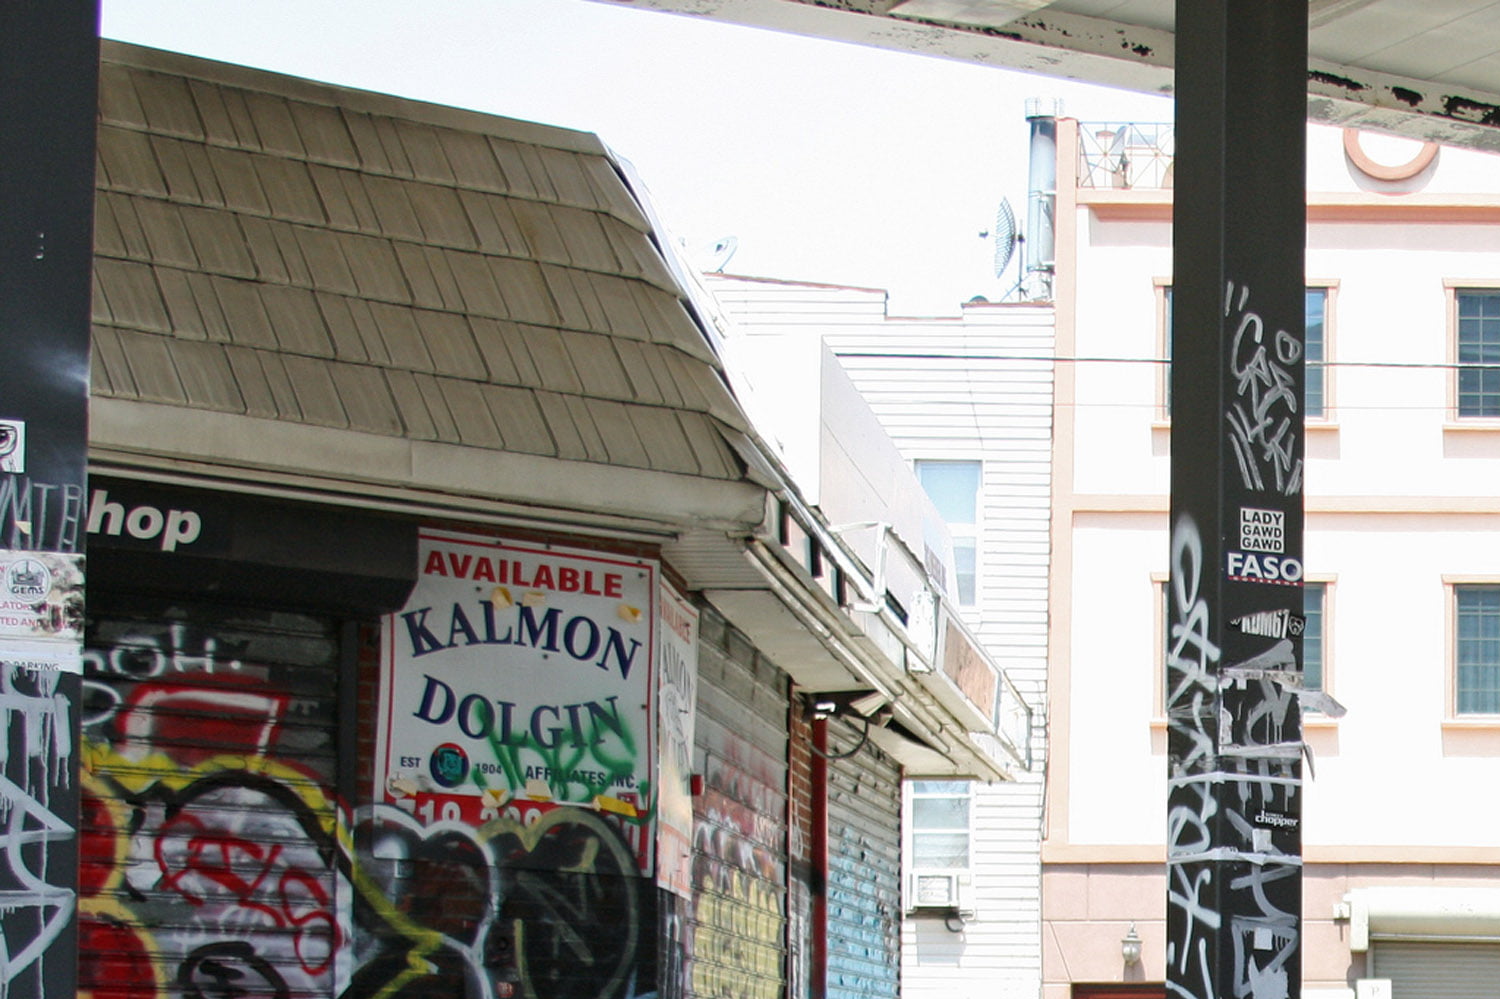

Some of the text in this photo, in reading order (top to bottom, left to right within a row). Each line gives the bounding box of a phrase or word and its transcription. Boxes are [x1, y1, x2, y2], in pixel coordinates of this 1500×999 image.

[1242, 510, 1283, 525] LADY
[1242, 524, 1282, 538] GAWD
[1242, 537, 1282, 551] GAWD
[424, 550, 623, 598] AVAILABLE
[1228, 552, 1303, 582] FASO
[401, 600, 642, 680] KALMON
[413, 674, 626, 750] DOLGIN
[400, 756, 502, 775] EST 1904
[526, 766, 606, 785] AFFATES
[1255, 810, 1298, 827] chopper
